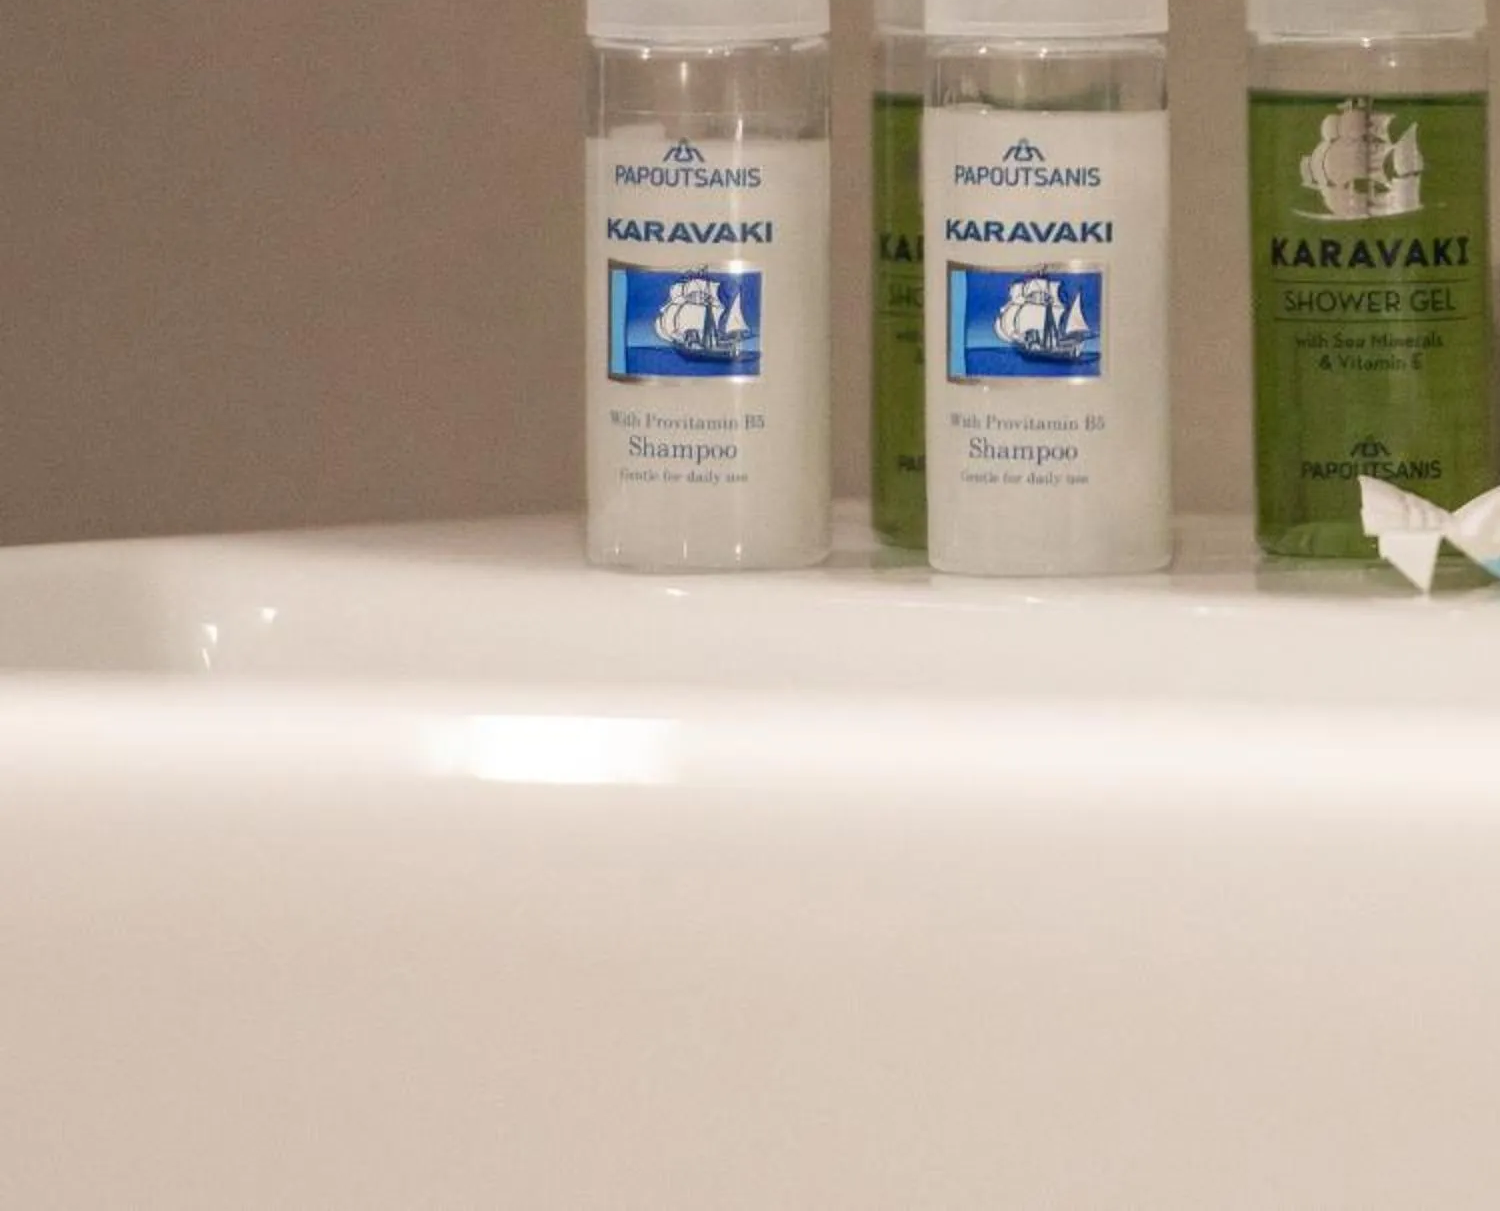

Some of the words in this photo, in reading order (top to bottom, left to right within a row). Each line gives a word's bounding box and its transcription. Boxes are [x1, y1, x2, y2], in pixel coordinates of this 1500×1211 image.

[614, 164, 761, 189] PAPOUTSANIS
[954, 164, 1101, 188] PAPOUTSANIS
[606, 217, 773, 244] KARAVAKI
[945, 219, 1113, 244] KARAVAKI
[1271, 236, 1470, 268] KARAVAKI
[1284, 291, 1400, 313] SHOWER
[1410, 290, 1456, 312] GEL
[1338, 353, 1406, 371] Vitamin
[610, 409, 641, 429] With
[645, 412, 739, 431] Provitamin
[745, 414, 766, 430] B5
[986, 414, 1079, 432] Provitamin
[628, 434, 738, 465] Shampoo
[968, 436, 1079, 466] Shampoo
